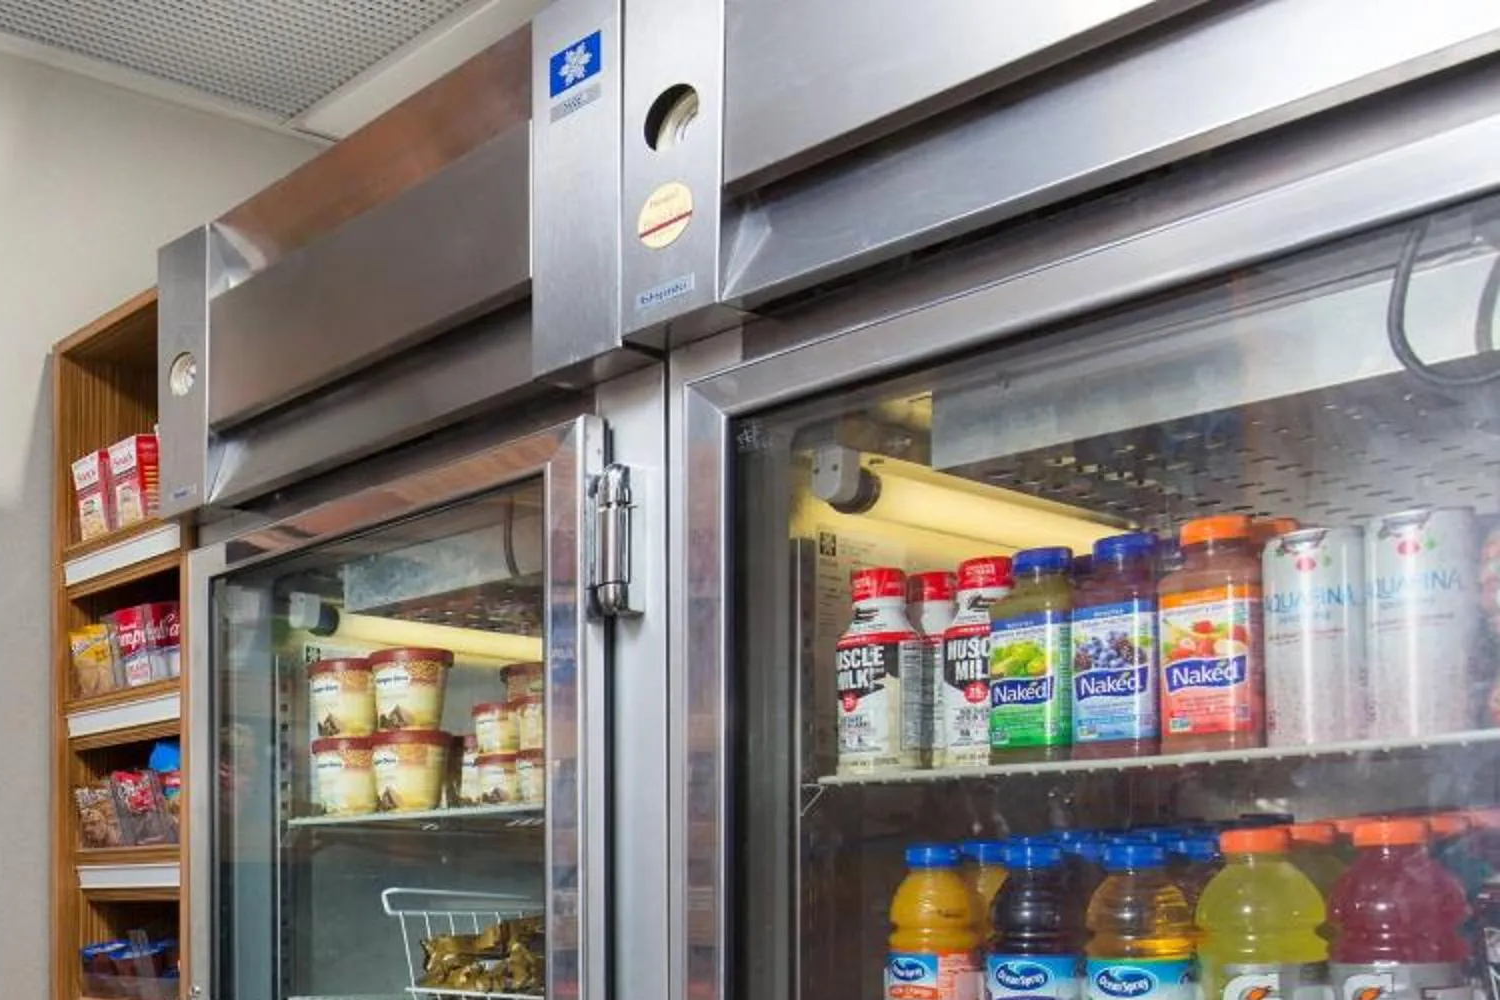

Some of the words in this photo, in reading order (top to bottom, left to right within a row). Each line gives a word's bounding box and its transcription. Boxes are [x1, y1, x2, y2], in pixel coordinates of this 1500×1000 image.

[1366, 571, 1463, 599] QUINA
[1266, 584, 1358, 613] AQUINA
[838, 644, 885, 671] USCLE
[947, 637, 991, 661] MUSC
[955, 660, 991, 681] MIL
[1171, 661, 1239, 687] Naked
[993, 682, 1050, 704] Naked
[1080, 671, 1143, 697] Naked
